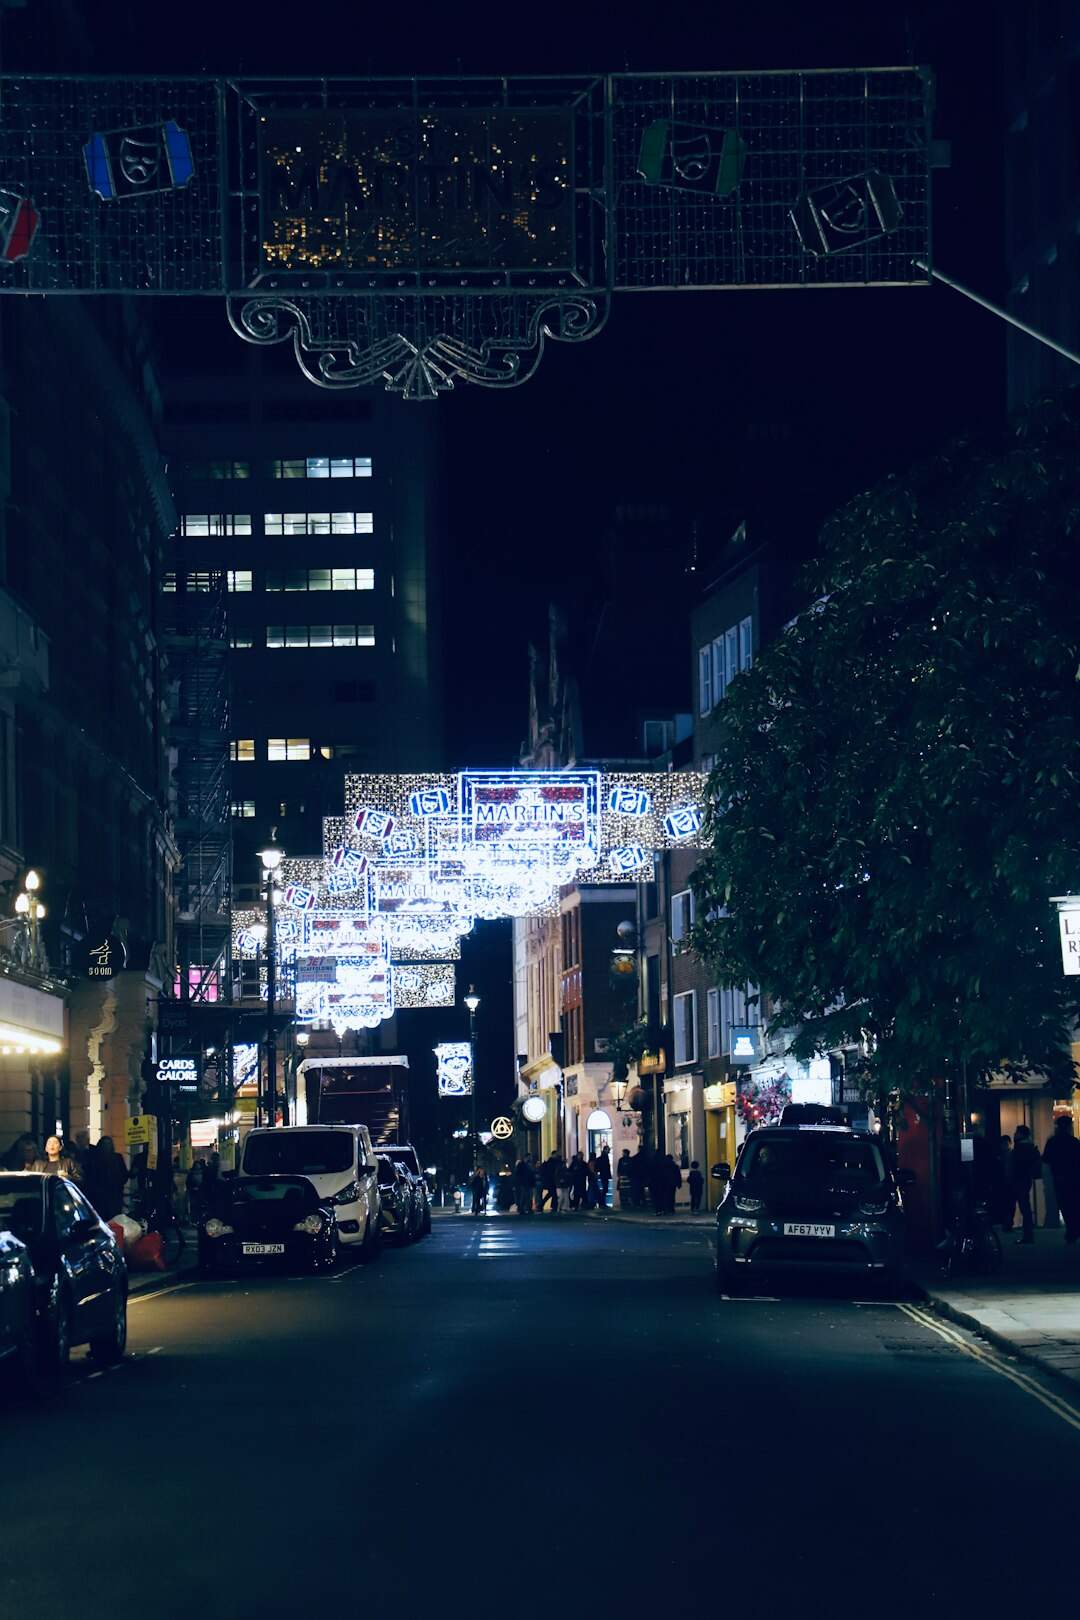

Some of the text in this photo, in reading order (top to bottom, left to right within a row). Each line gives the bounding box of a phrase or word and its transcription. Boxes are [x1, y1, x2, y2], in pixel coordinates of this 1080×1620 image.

[476, 804, 584, 822] MARTIN'S
[1064, 919, 1080, 935] L
[159, 1059, 195, 1070] CARDS
[156, 1070, 198, 1081] GALORE
[788, 1225, 811, 1235] AF67
